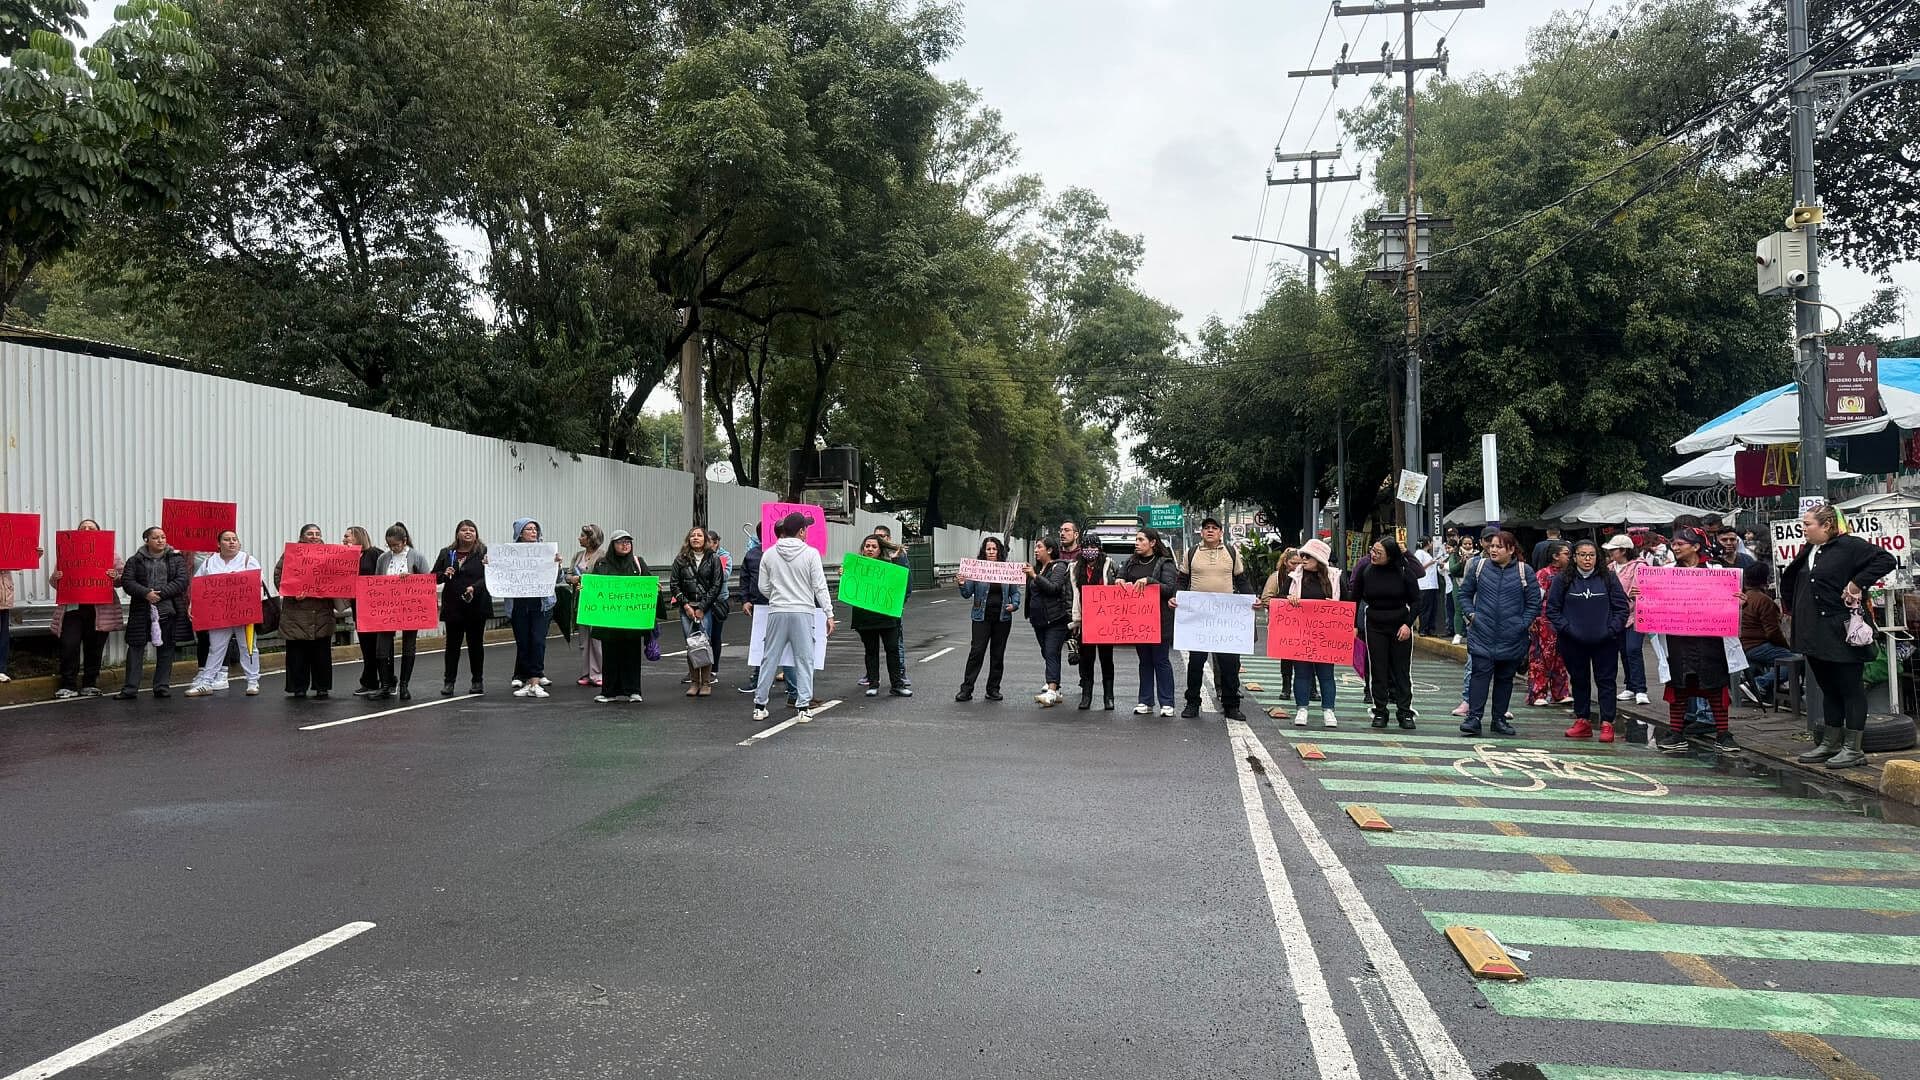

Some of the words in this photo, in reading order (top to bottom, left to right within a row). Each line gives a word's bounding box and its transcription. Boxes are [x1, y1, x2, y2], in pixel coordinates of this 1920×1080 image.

[1775, 524, 1803, 540] BAS
[596, 591, 605, 600] A
[1092, 589, 1108, 603] LA
[584, 603, 598, 612] NO
[602, 603, 623, 612] HAY
[1275, 613, 1300, 628] POR
[1305, 646, 1318, 655] DE
